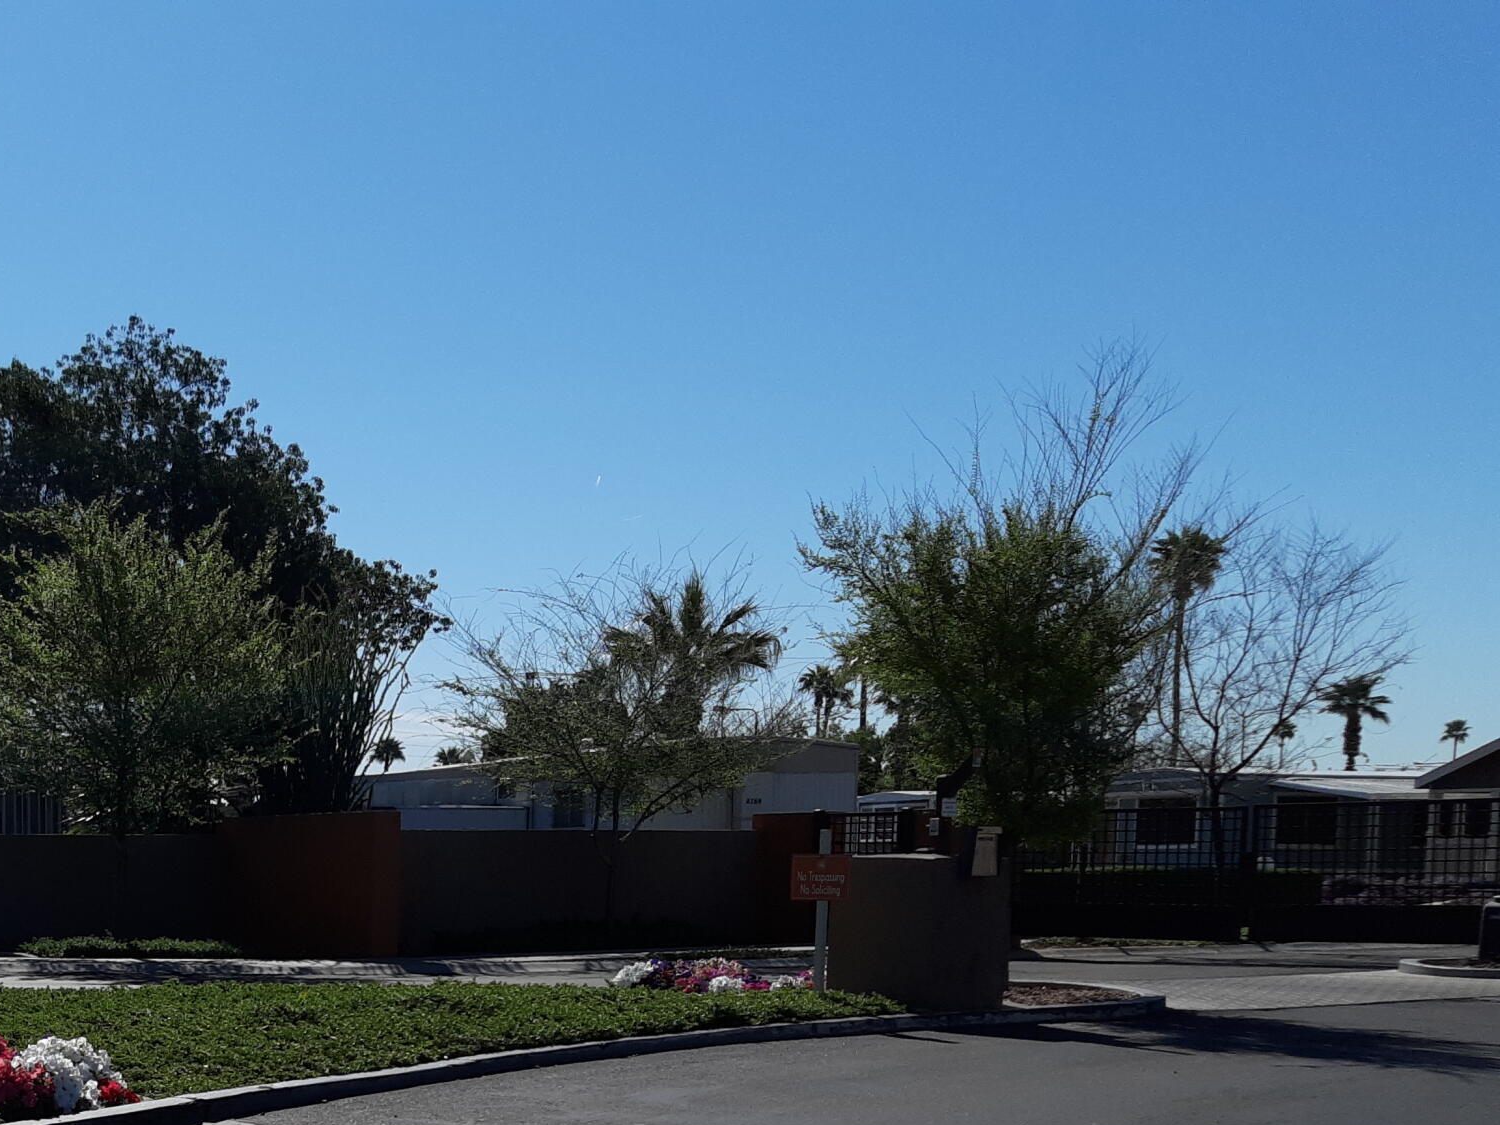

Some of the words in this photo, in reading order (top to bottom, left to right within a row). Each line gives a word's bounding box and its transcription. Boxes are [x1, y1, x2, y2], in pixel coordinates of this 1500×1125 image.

[797, 871, 807, 881] No
[809, 870, 845, 885] Trespassing
[799, 884, 810, 895] No
[811, 883, 841, 897] Soliciting
